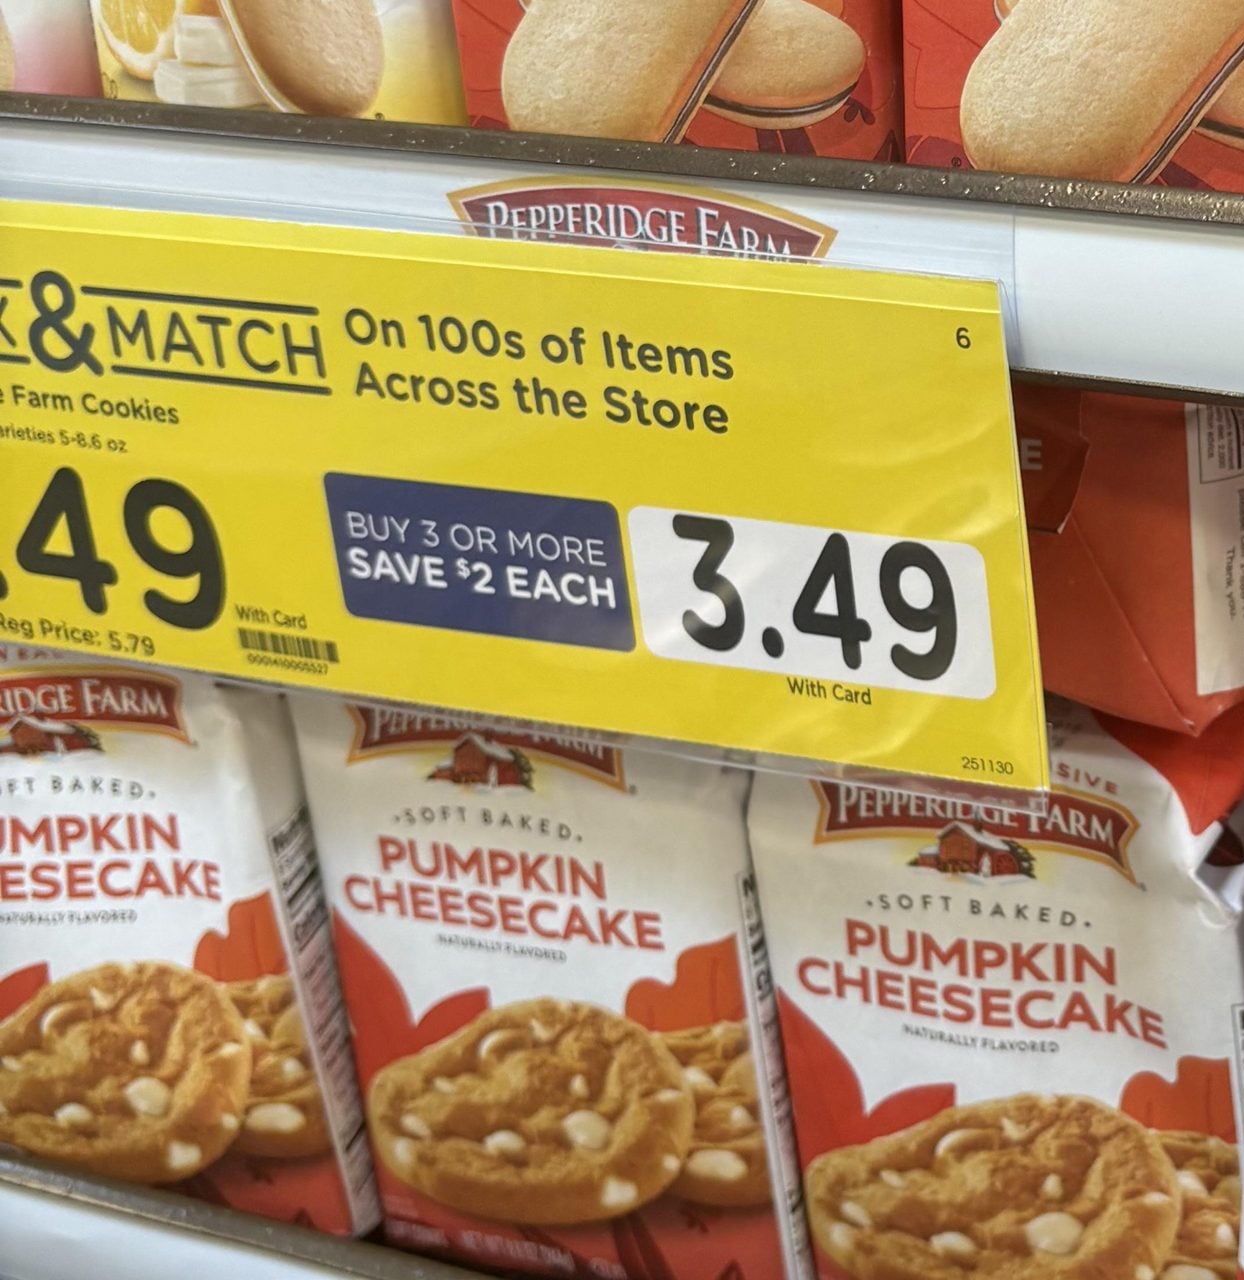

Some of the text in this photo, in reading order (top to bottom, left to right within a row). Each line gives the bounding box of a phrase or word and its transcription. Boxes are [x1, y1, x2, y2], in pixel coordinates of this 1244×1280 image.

[29, 270, 104, 377] &
[106, 304, 327, 379] MATCH
[344, 307, 735, 380] On 100s of Items
[955, 327, 972, 350] 6
[11, 385, 74, 413] Farm
[81, 392, 180, 424] Cookies
[354, 361, 730, 434] Across the Store
[0, 423, 129, 453] arieties 5-8.6 oz
[348, 512, 608, 567] BUY 3 OR MORE
[348, 548, 618, 610] SAVE $2 EACH
[1224, 547, 1236, 586] Thank
[235, 603, 308, 630] With Card
[672, 512, 959, 682] 3.49
[41, 618, 156, 657] Price: 5.79
[81, 677, 170, 719] FARM
[786, 675, 873, 706] With Card
[961, 754, 1015, 776] 251130
[51, 775, 144, 800] BAKED
[402, 806, 573, 843] SOFT BAKED
[1028, 794, 1116, 850] FARM
[0, 858, 222, 903] ESECAKE
[378, 833, 608, 902] PUMPKIN
[343, 873, 666, 952] CHEESECAKE
[877, 893, 1077, 928] SOFT BAKED
[437, 933, 568, 964] NATURALLY FLAVORED
[846, 916, 1118, 988] PUMPKIN
[795, 956, 1170, 1051] CHEESECAKE
[902, 1023, 1061, 1055] NATURALLY FLAVORED
